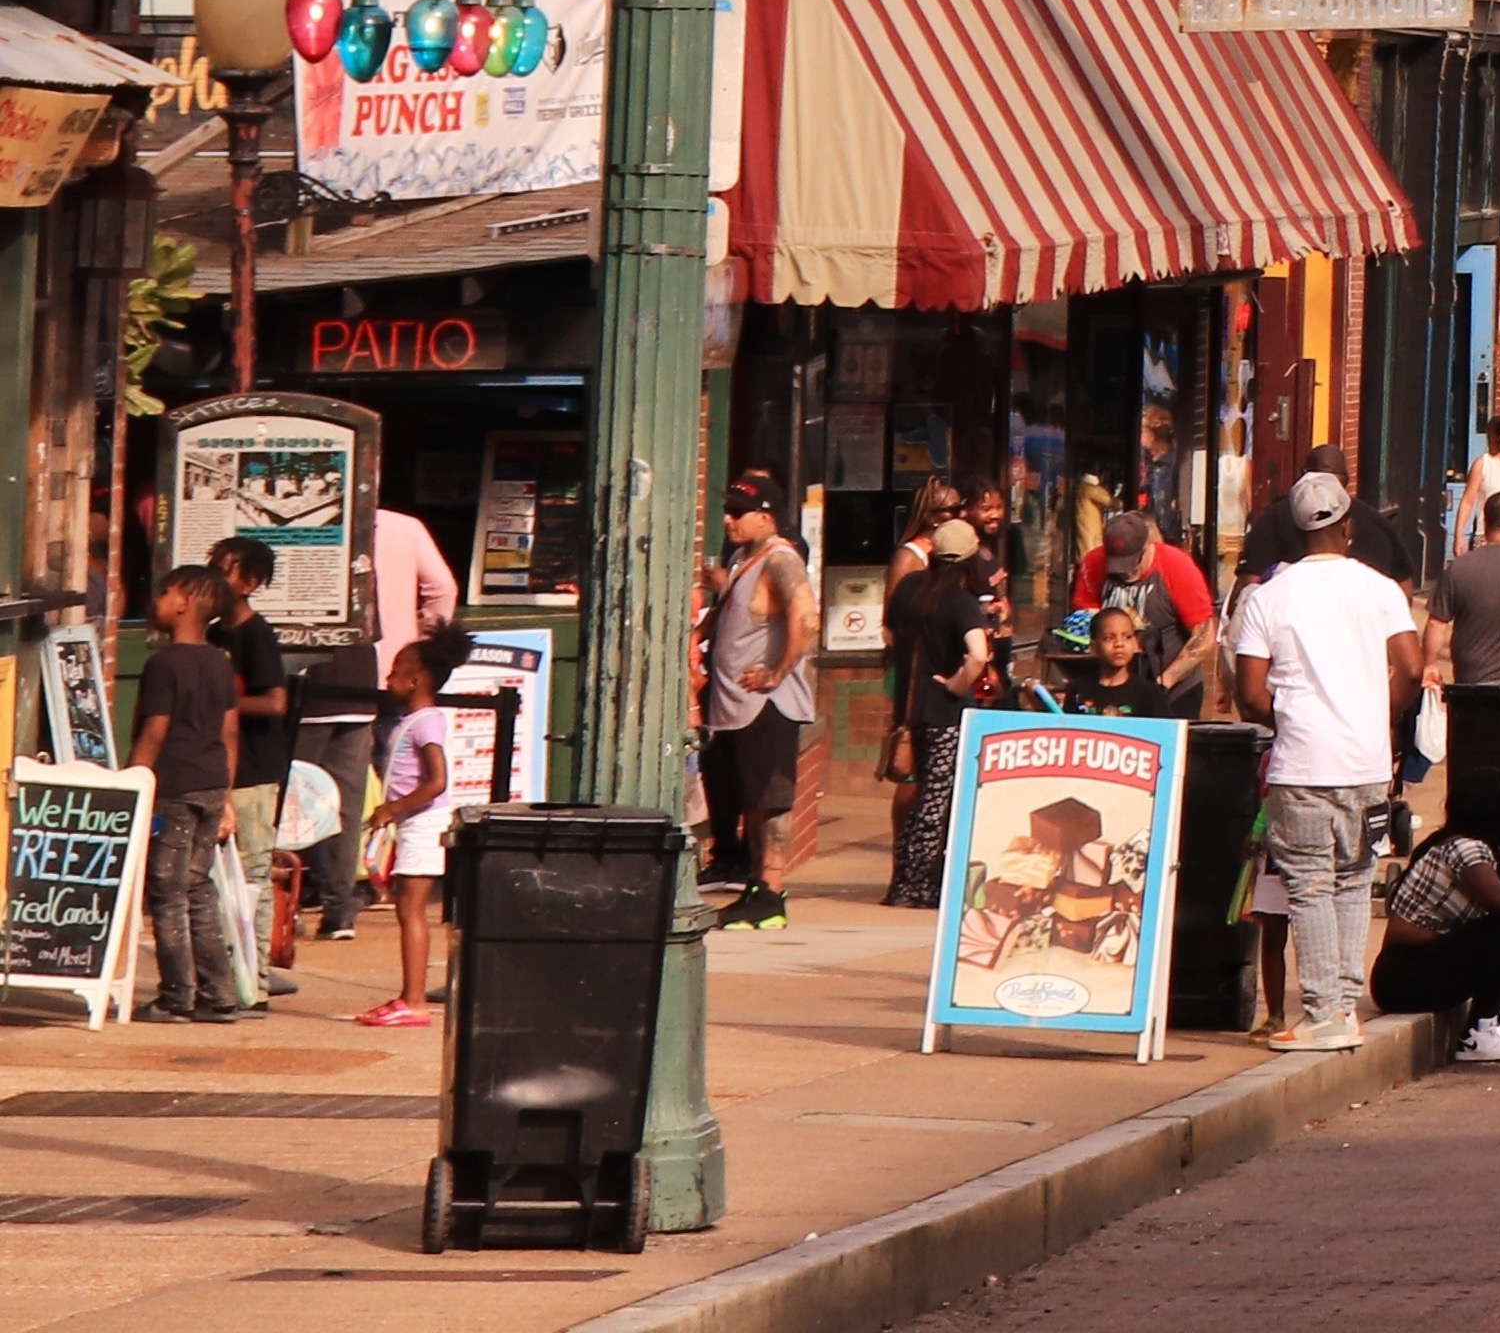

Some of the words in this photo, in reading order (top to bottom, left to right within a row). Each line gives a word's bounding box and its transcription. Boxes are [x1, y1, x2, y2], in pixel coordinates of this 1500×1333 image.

[351, 90, 465, 137] PUNCH
[311, 317, 477, 372] PATIO
[984, 735, 1066, 773] FRESH
[1071, 738, 1153, 780] FUDGE
[18, 786, 61, 828] We
[62, 791, 131, 833] Have
[53, 886, 111, 942] Candy
